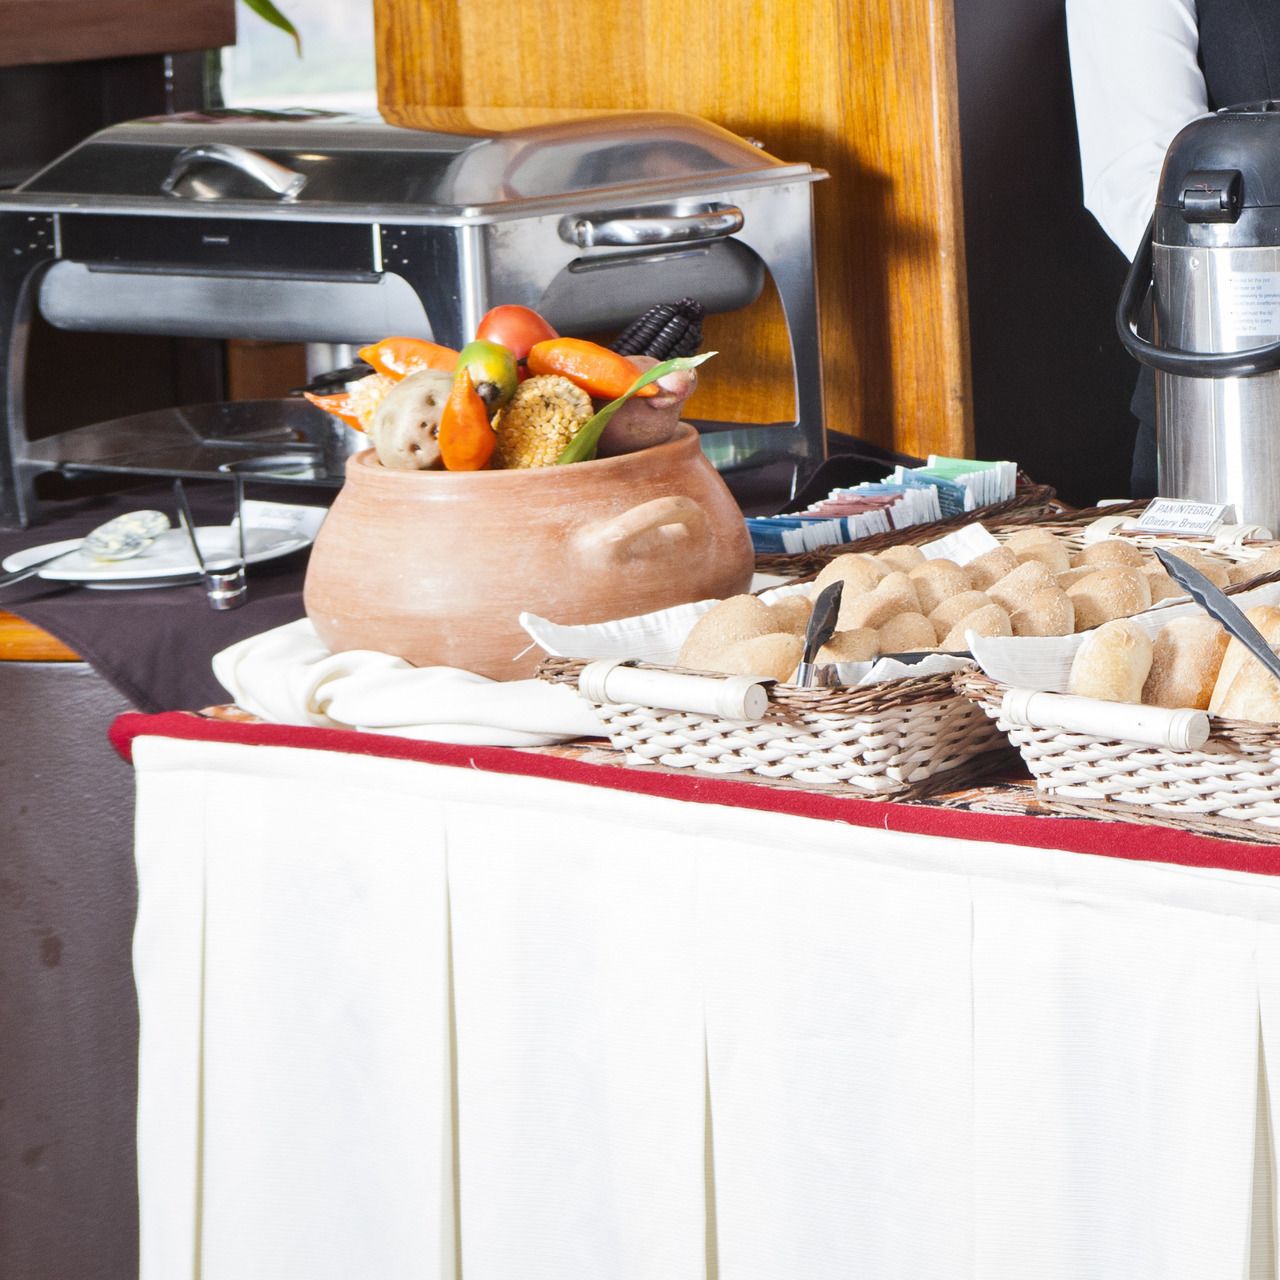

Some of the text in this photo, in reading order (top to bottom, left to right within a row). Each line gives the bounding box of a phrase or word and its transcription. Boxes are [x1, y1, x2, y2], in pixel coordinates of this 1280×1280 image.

[1156, 503, 1217, 517] PAN INTEGRAL
[1179, 518, 1211, 529] Bread)
